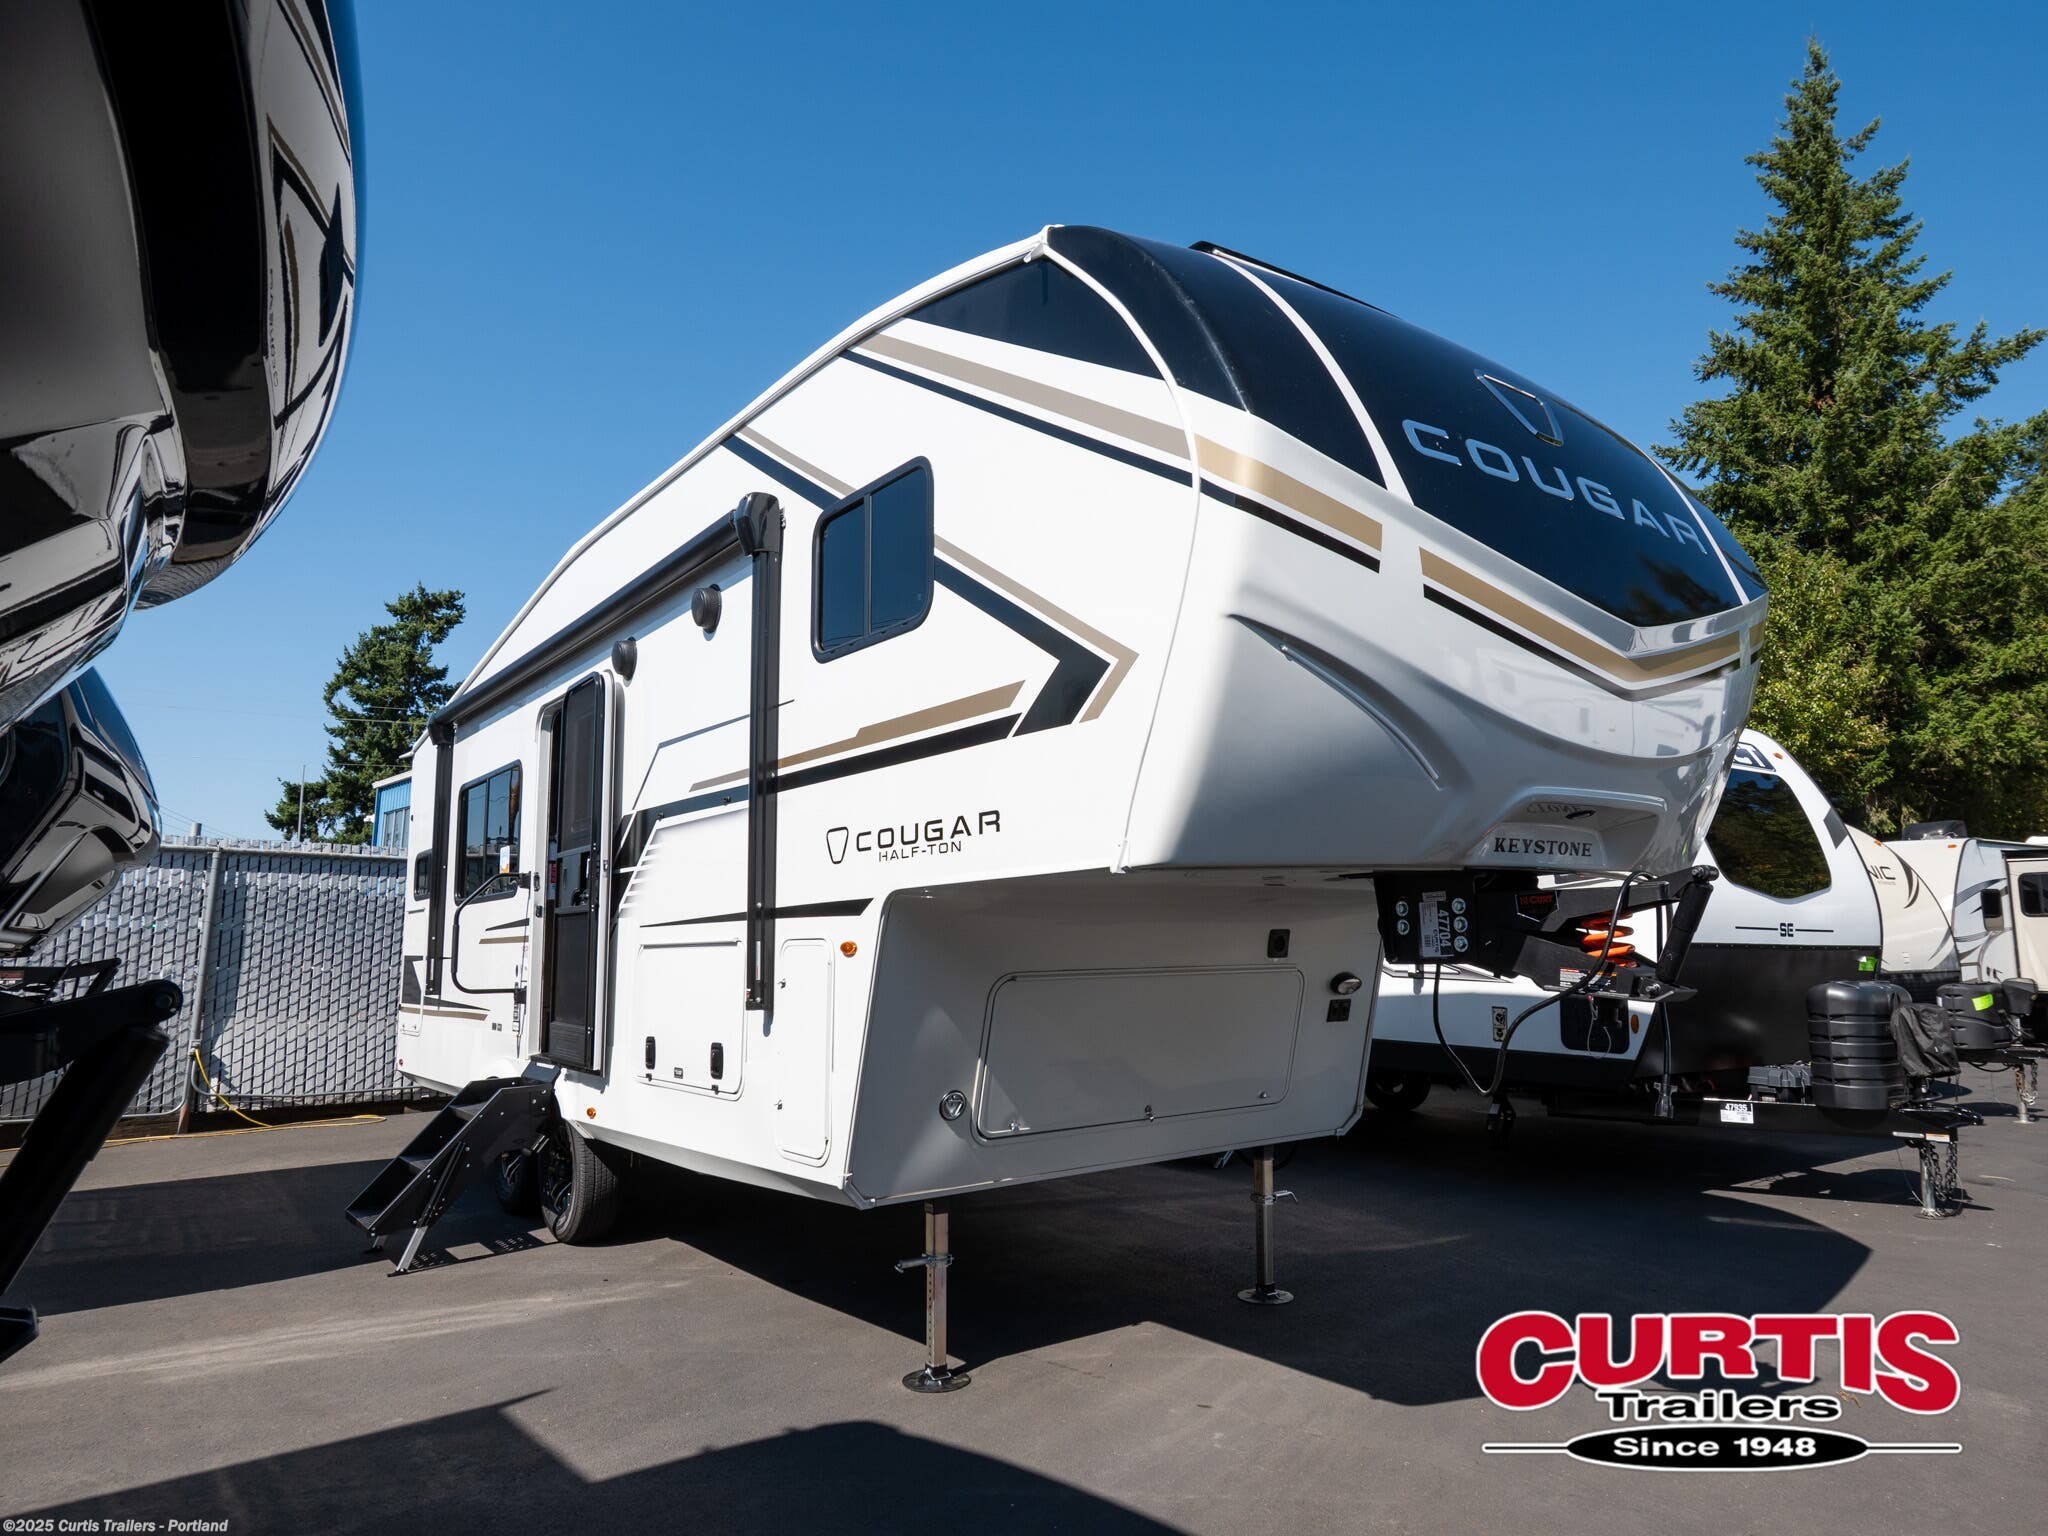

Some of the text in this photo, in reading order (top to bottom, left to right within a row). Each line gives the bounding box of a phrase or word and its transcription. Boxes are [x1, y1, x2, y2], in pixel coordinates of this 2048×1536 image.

[1402, 418, 1708, 555] COUGAR
[856, 810, 1001, 852] COUGAR
[878, 841, 962, 863] HALF-TON
[1494, 837, 1593, 857] KEYSTONE
[1438, 909, 1451, 947] 47704
[1779, 922, 1794, 938] SE
